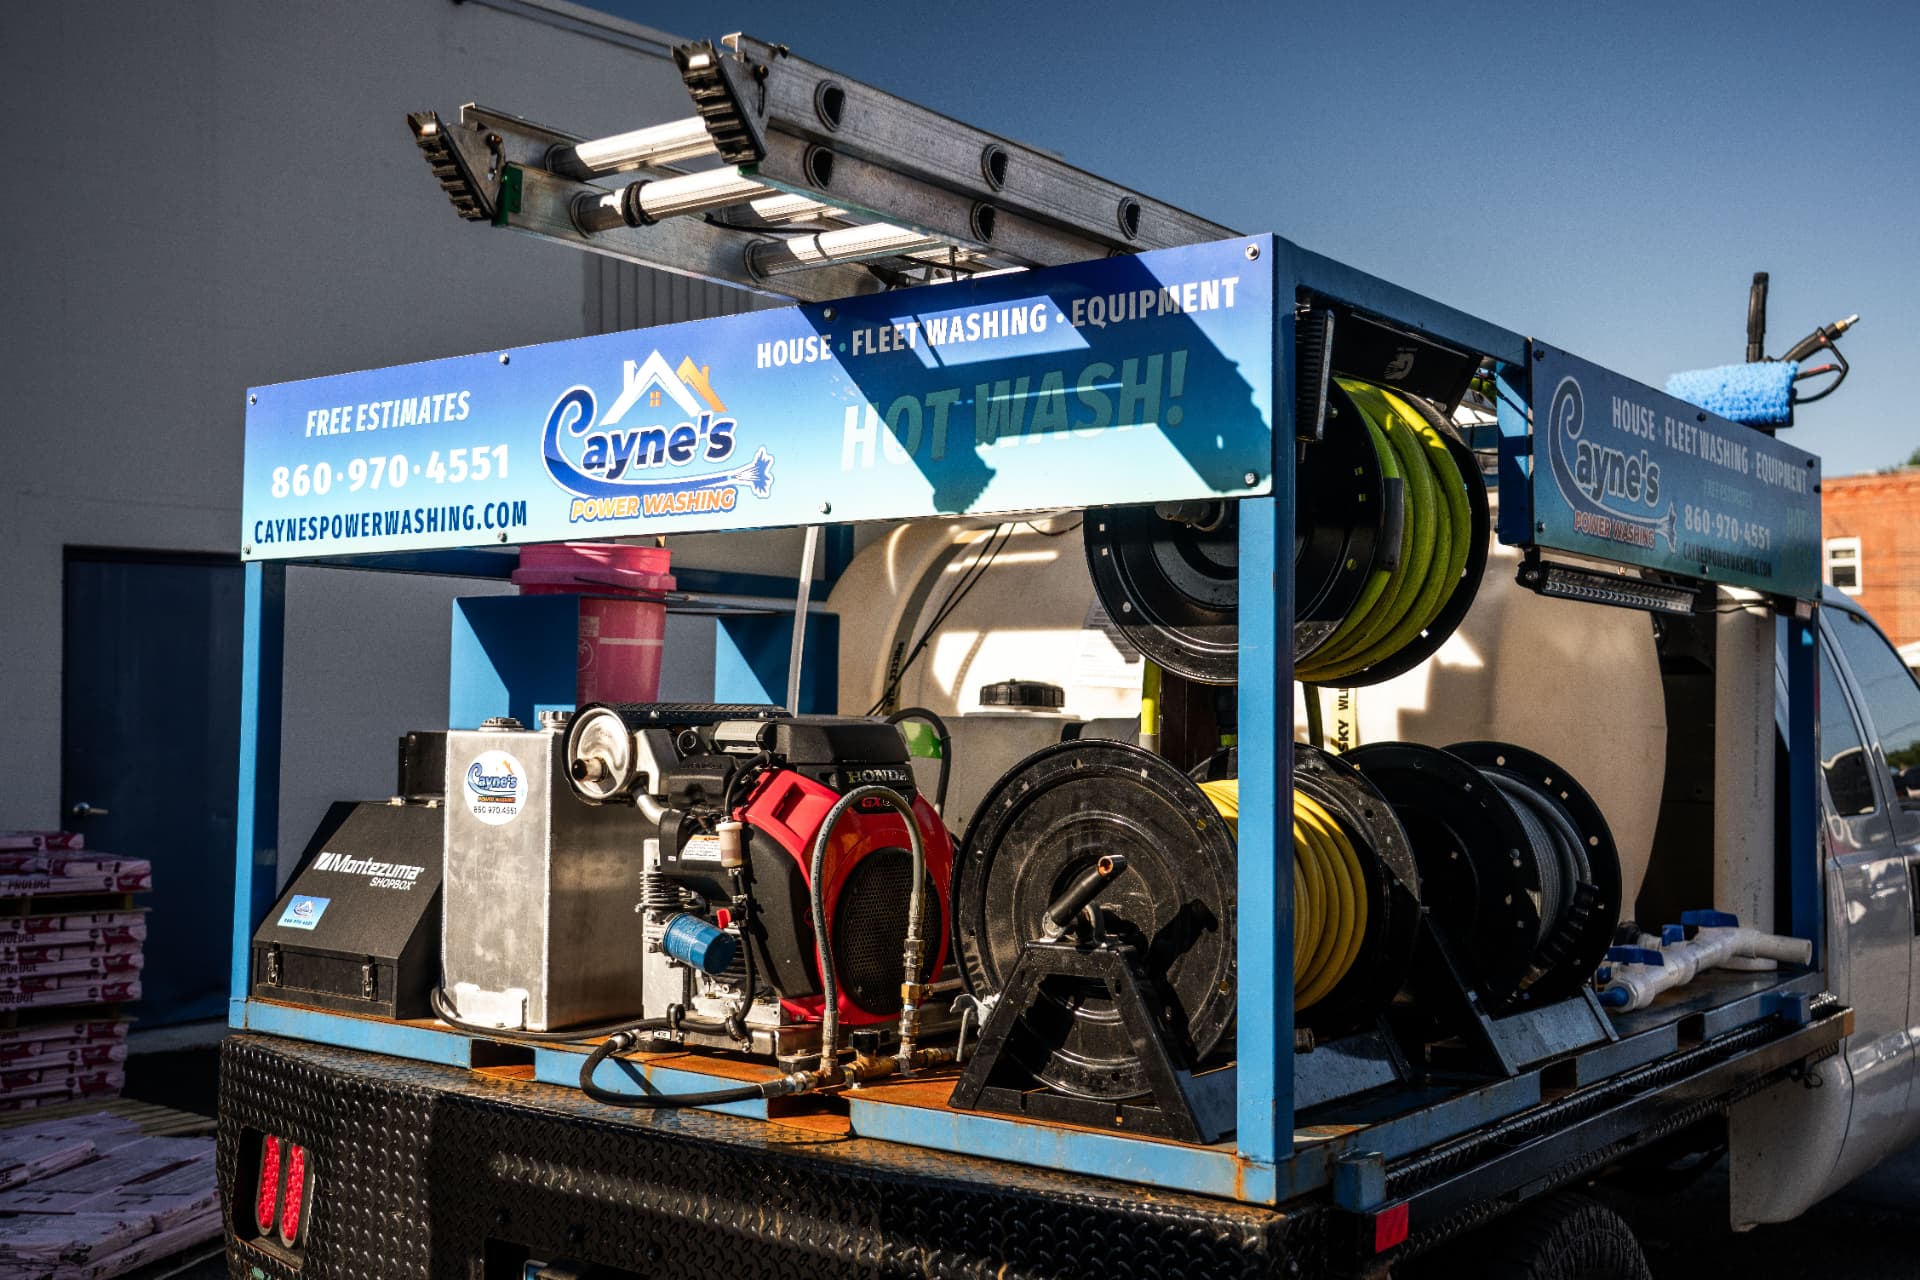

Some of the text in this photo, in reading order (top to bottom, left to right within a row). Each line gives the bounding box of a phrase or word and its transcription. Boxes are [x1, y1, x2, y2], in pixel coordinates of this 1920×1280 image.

[757, 276, 1239, 368] HOUSE FLEET WASHING EQUIPMENT
[305, 391, 471, 438] FREE ESTIMATES
[840, 348, 1188, 473] HOT WASH!
[541, 384, 738, 498] Cayne's
[1548, 375, 1661, 516] Cayne's
[1612, 396, 1808, 495] HOUSE FLEET WASHING EQUIPMENT
[254, 500, 528, 545] CAYNESPOWERWASHING.COM
[570, 488, 737, 522] POWER WASHING
[1573, 509, 1656, 550] POWER WASHING
[467, 762, 518, 797] Cayne's
[328, 852, 421, 880] Montezuma
[370, 876, 414, 891] SHOPBOX
